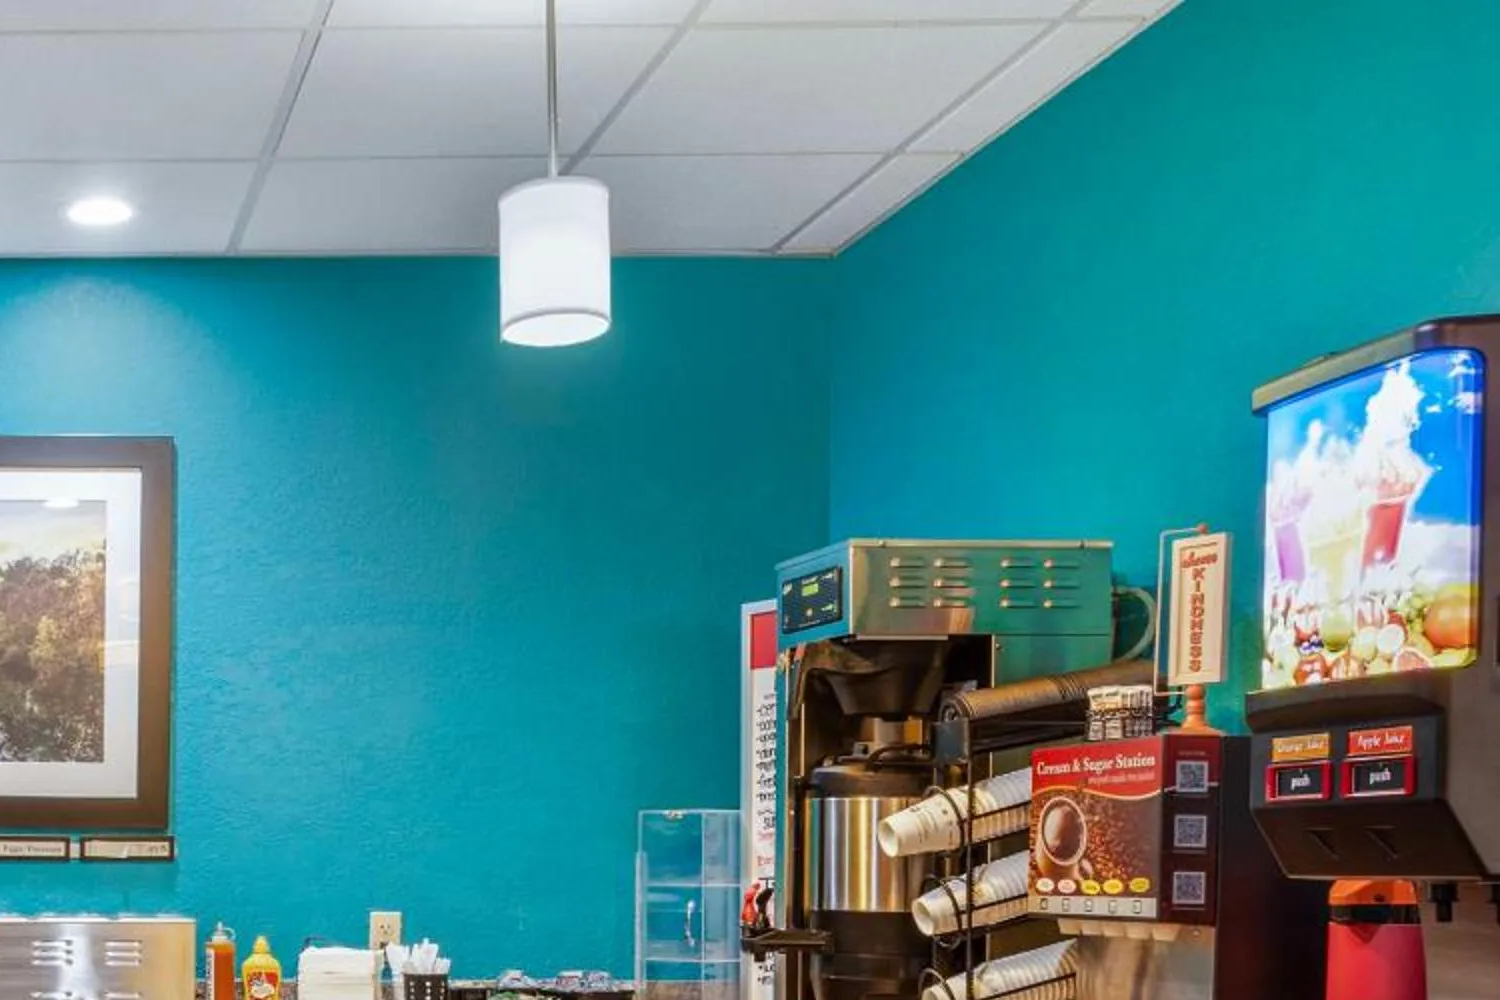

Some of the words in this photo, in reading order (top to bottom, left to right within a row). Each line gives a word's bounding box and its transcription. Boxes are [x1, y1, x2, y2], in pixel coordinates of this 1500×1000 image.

[1189, 567, 1205, 673] KINDNESS
[1357, 735, 1381, 750] Apple
[1384, 732, 1405, 745] Juice
[1036, 760, 1071, 776] Cream
[1072, 757, 1081, 772] &
[1083, 756, 1114, 775] Sugar
[1115, 752, 1156, 769] Station
[1290, 773, 1311, 791] push
[1368, 767, 1392, 785] push
